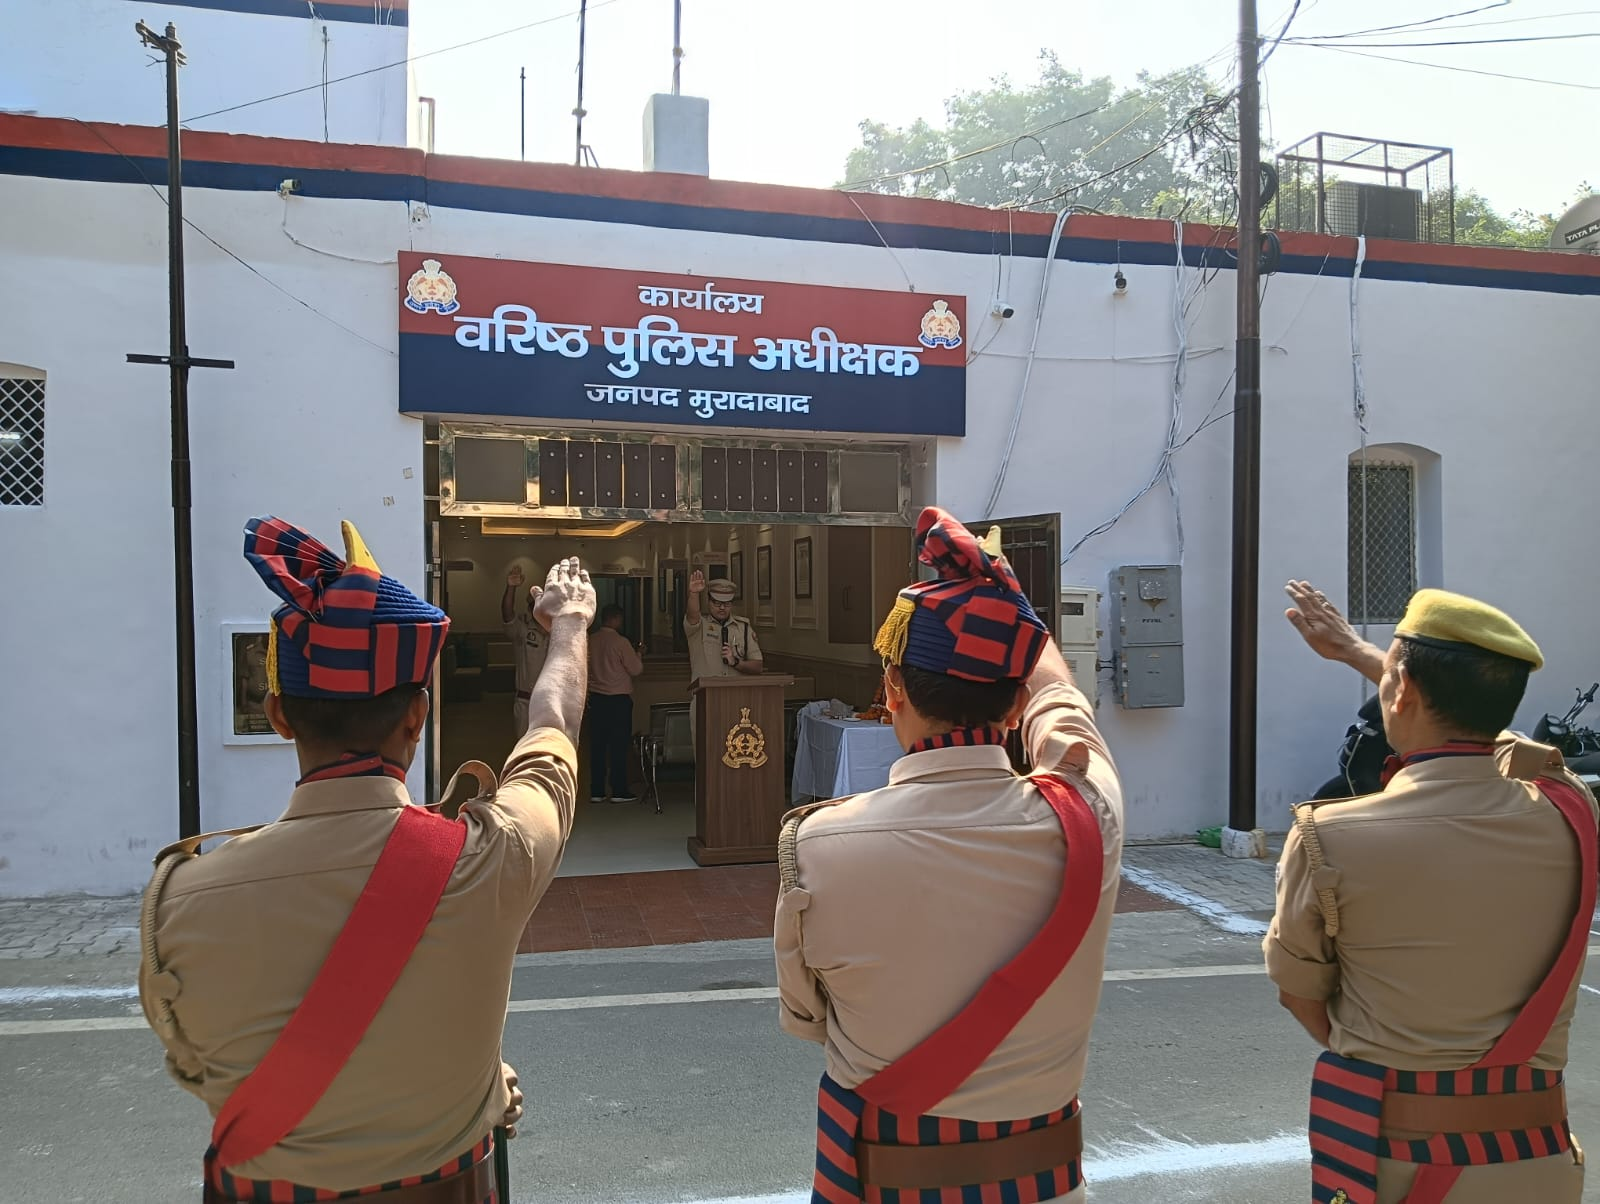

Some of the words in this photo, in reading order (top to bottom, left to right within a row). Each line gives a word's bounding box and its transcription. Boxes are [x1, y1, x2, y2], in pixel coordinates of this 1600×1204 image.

[1566, 230, 1588, 241] TATA
[638, 282, 764, 315] कार्यालय
[454, 304, 591, 358] वरिष्ठ
[601, 314, 738, 379] पुलिस
[749, 326, 923, 377] अधीक्षक
[584, 383, 681, 407] जनपद
[689, 389, 812, 419] मुरादाबाद
